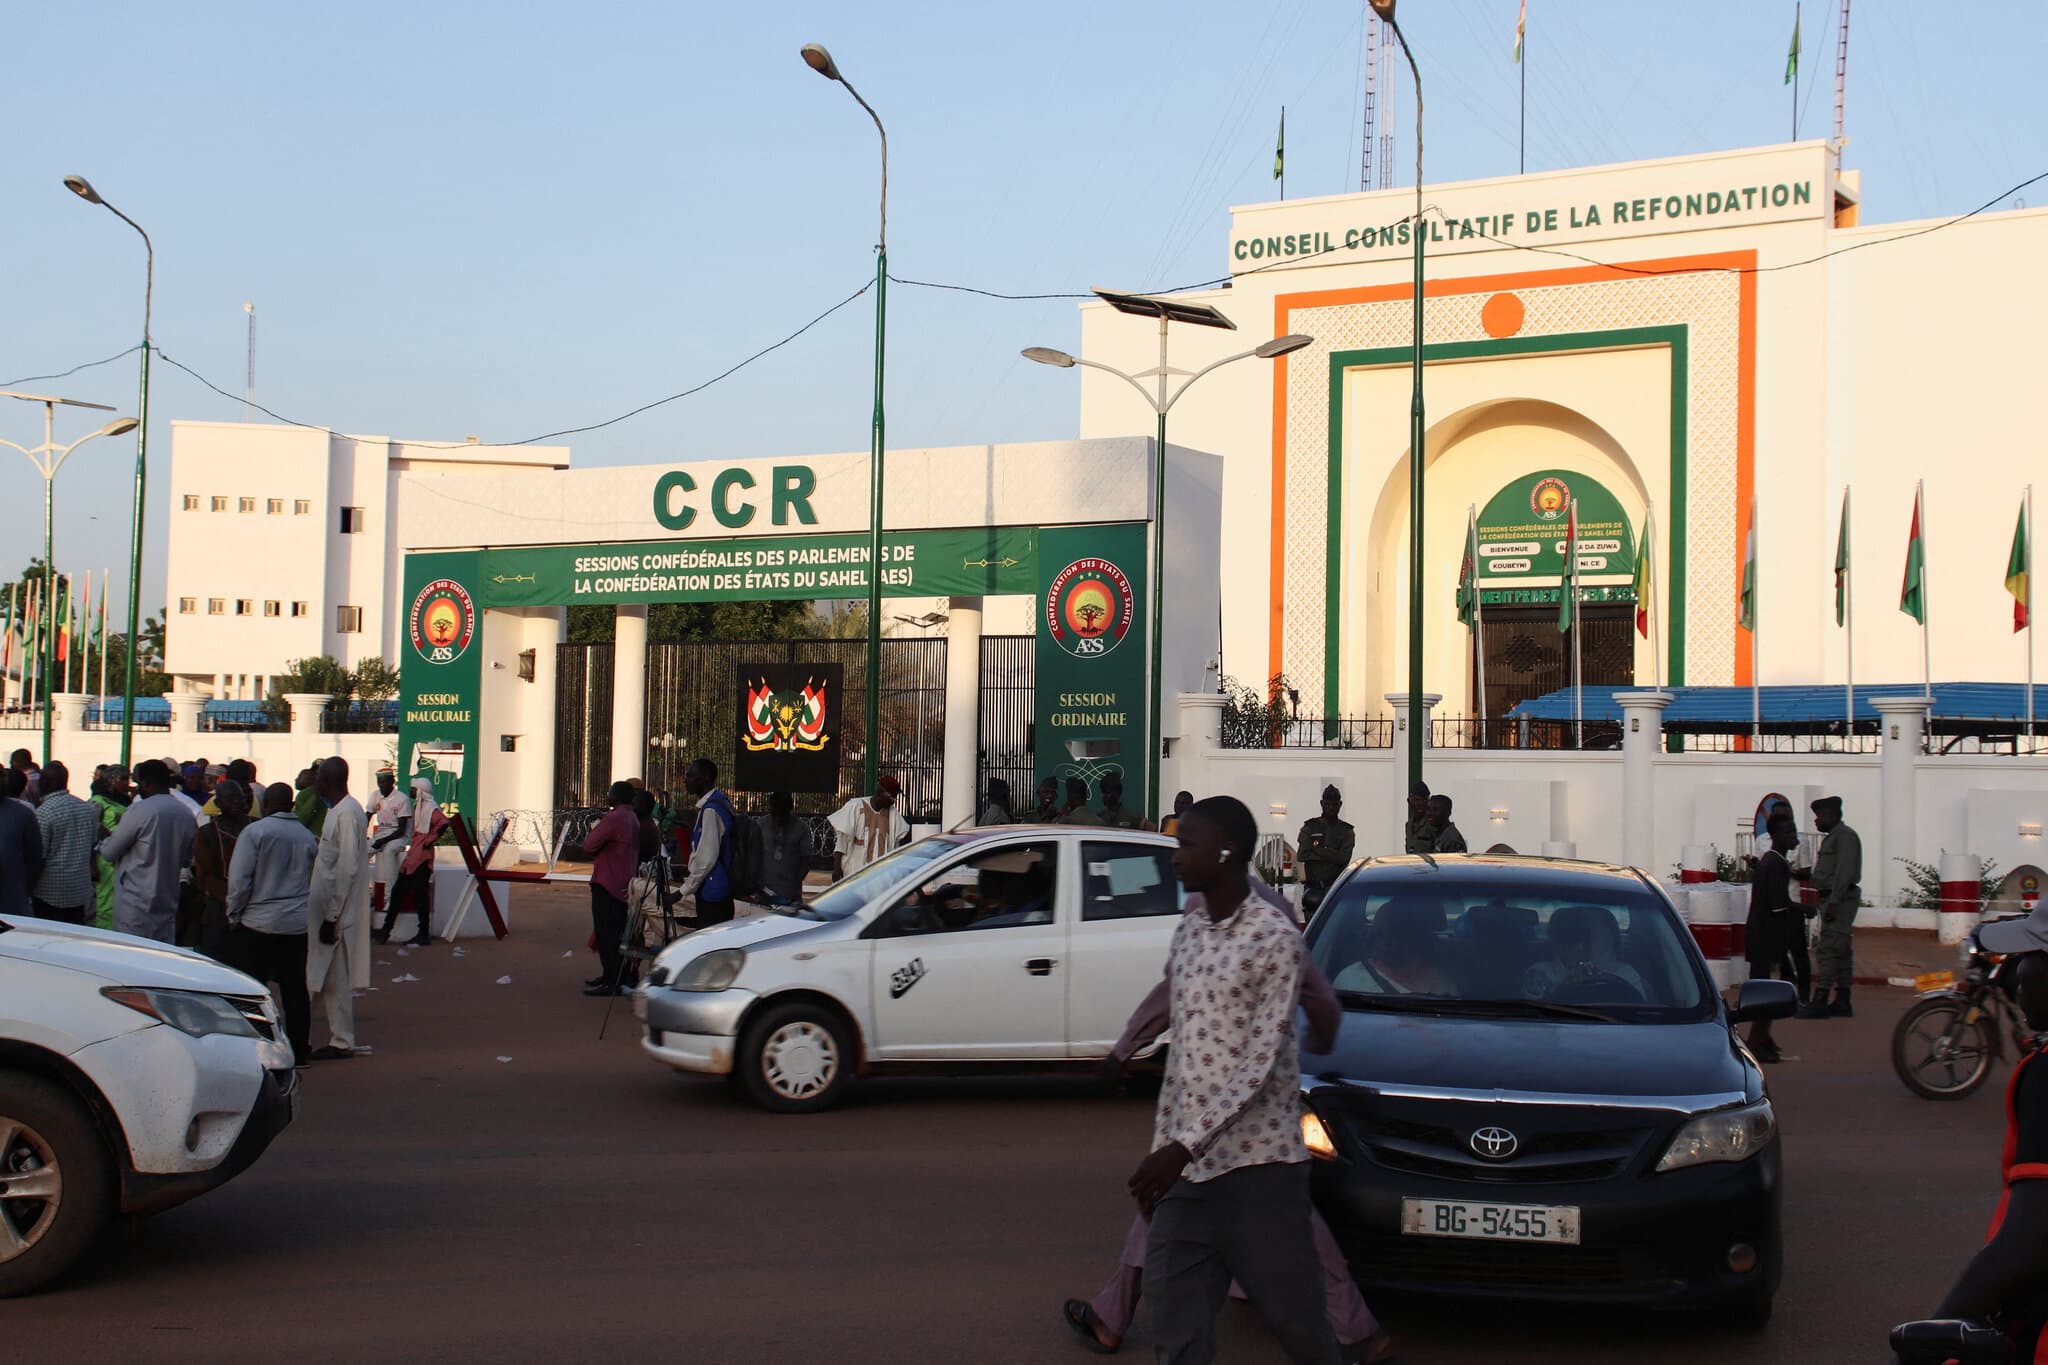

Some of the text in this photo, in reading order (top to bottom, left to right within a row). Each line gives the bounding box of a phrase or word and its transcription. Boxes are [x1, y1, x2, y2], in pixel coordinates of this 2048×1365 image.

[1234, 231, 1335, 260] CONSEIL
[1525, 209, 1558, 233] DE
[1570, 203, 1602, 229] LA
[1613, 180, 1812, 224] REFONDATION
[653, 465, 818, 531] CCR
[575, 545, 915, 573] SESSIONS CONFÉDÉRALES DES PARLEMENS DE
[1080, 560, 1096, 569] DES
[1099, 562, 1121, 579] ETATS
[574, 566, 913, 594] LA CONFÉDÉRATION DES ÉTATS DU SAHEL AES)
[1119, 580, 1129, 593] DU
[1121, 597, 1131, 625] SAHEL
[430, 647, 453, 660] AES
[1074, 638, 1105, 654] AES
[416, 693, 460, 706] SESSION
[1059, 692, 1117, 707] SESSION
[406, 710, 472, 723] INAUGURALE
[1050, 712, 1128, 727] ORDINAIRE
